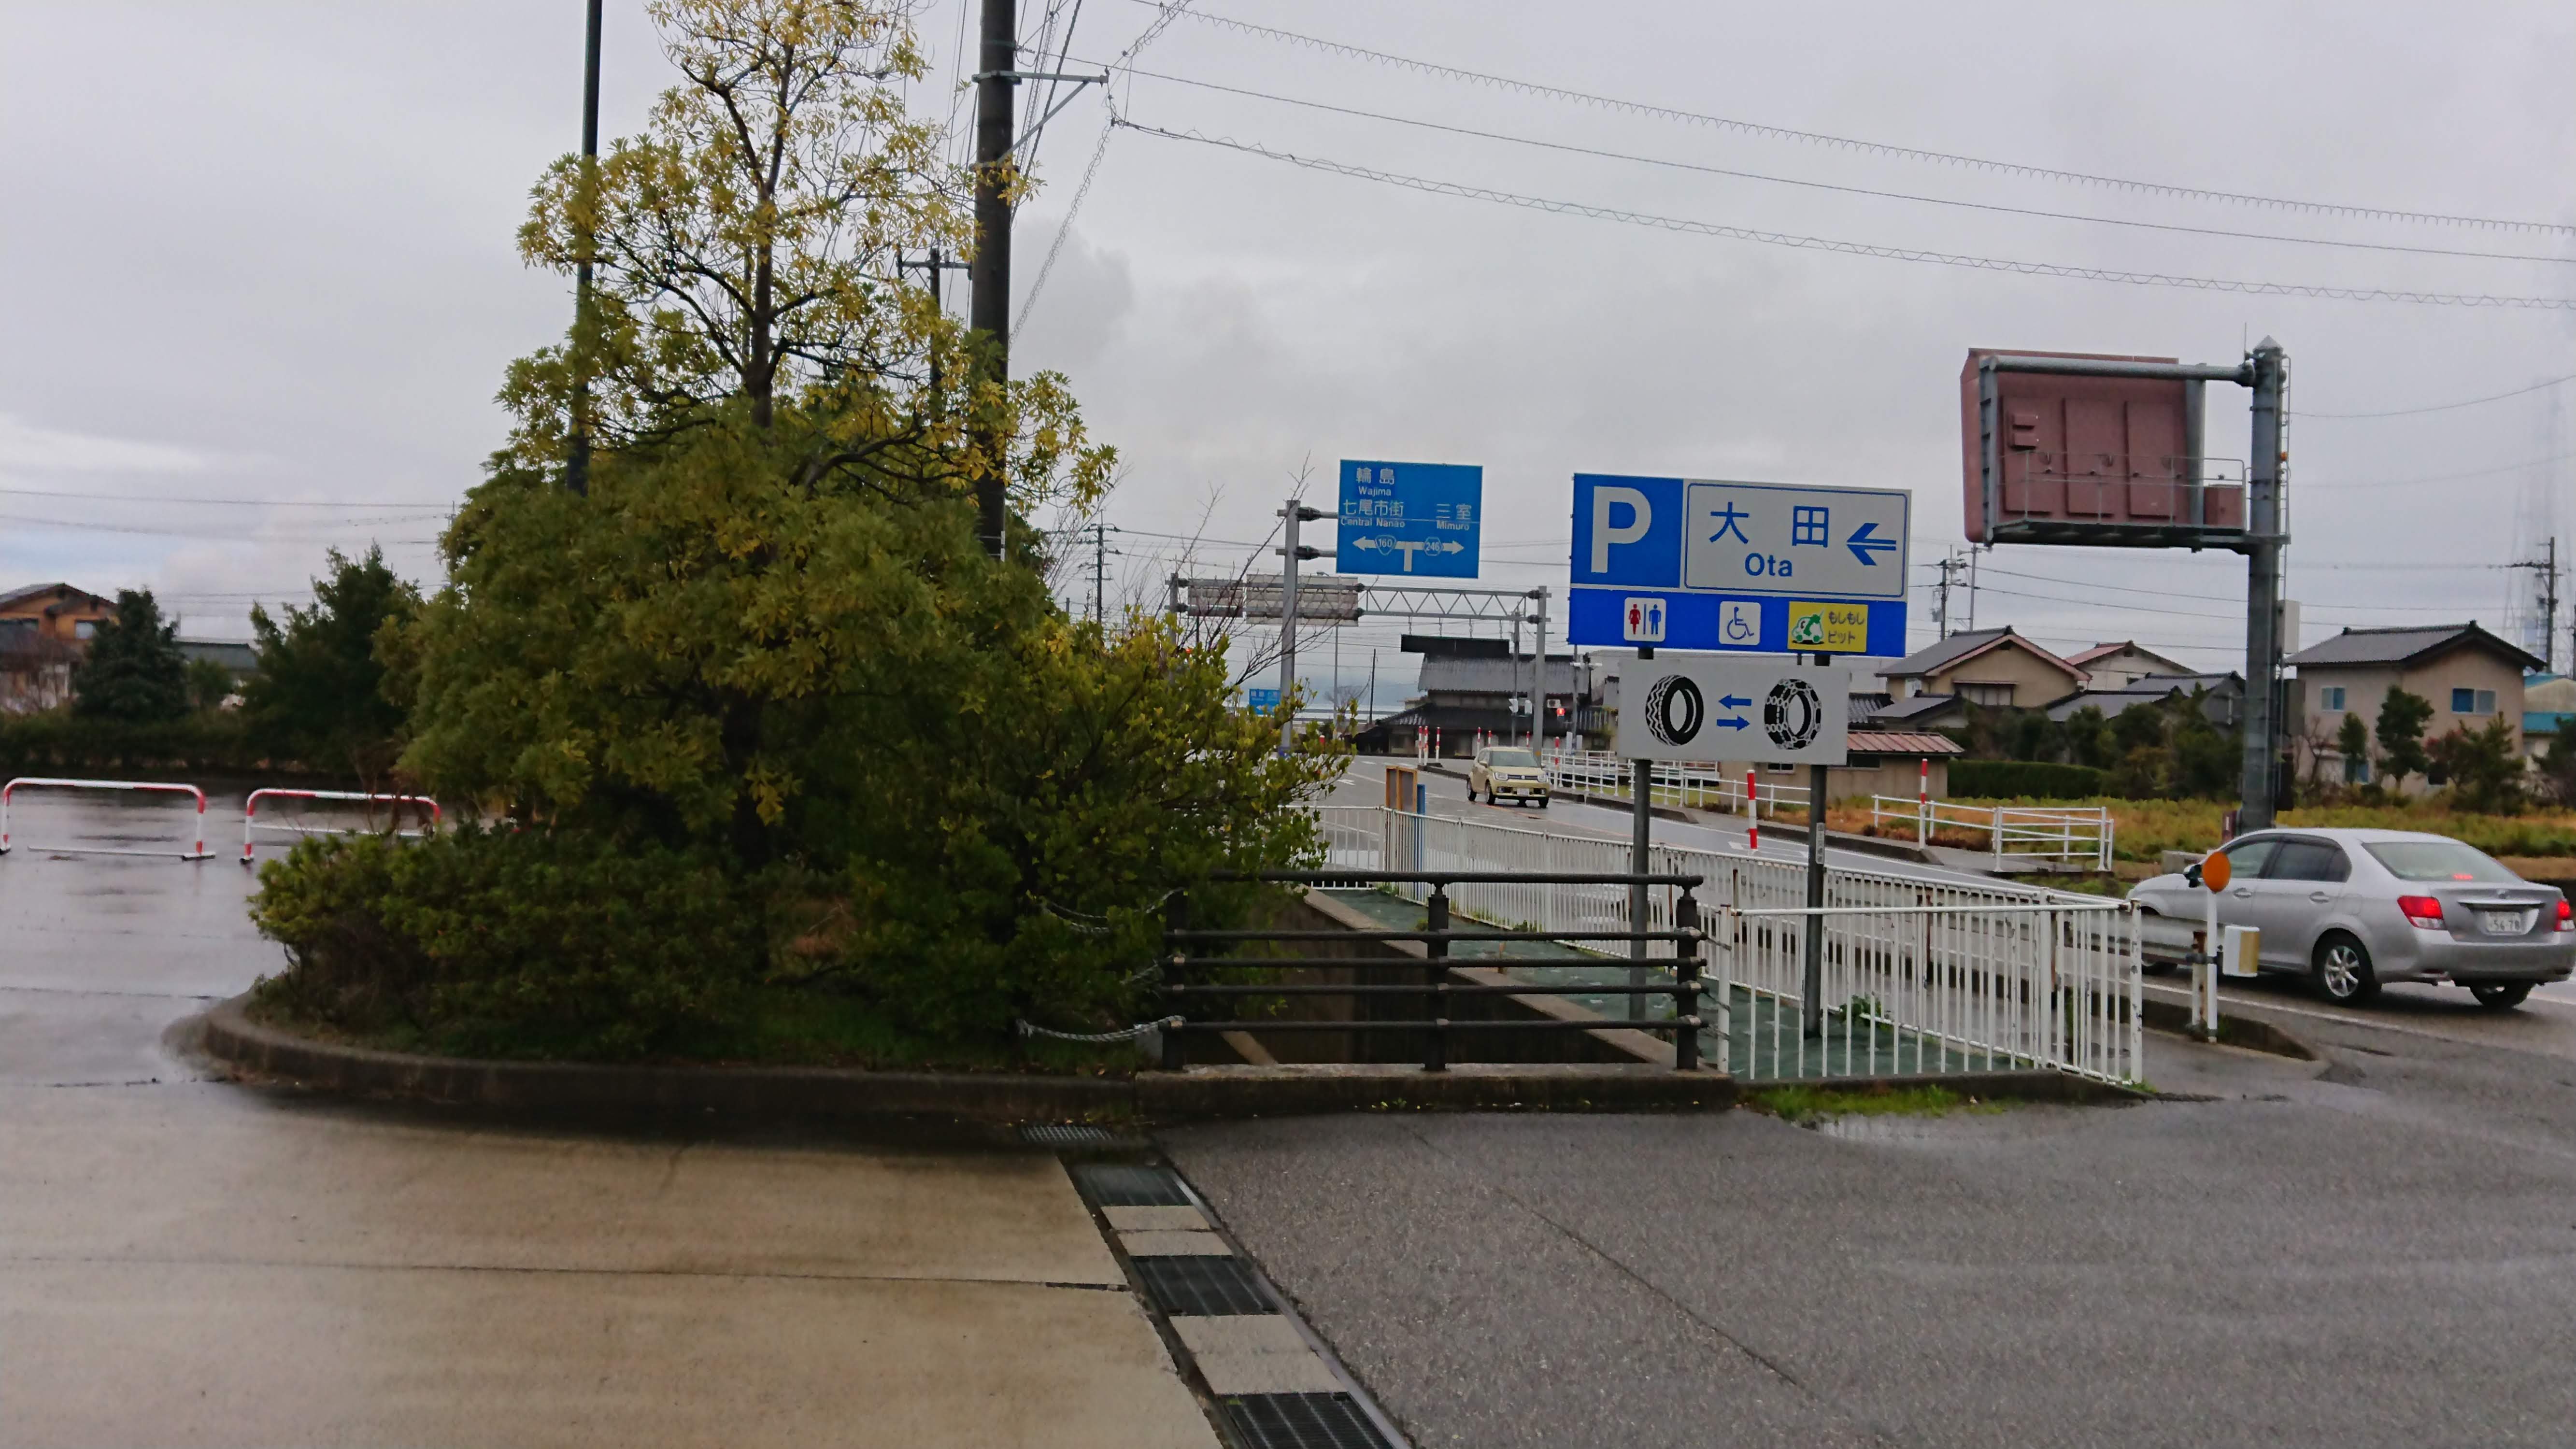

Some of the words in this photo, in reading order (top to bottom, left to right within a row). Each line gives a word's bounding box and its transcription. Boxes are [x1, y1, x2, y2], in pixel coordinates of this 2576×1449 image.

[1356, 468, 1395, 484] 輪島
[1358, 486, 1392, 497] Wajima
[1343, 499, 1404, 516] 七尾市街
[1436, 503, 1472, 520] 三室
[1340, 518, 1372, 526] Central
[1377, 518, 1405, 528] Nanao
[1437, 521, 1469, 531] Mimuro
[1591, 486, 1651, 573] P
[1709, 501, 1829, 548] 大田
[1378, 539, 1393, 548] 160
[1425, 541, 1440, 551] 246
[1745, 553, 1793, 577] Ota
[1829, 611, 1864, 625] もしもし
